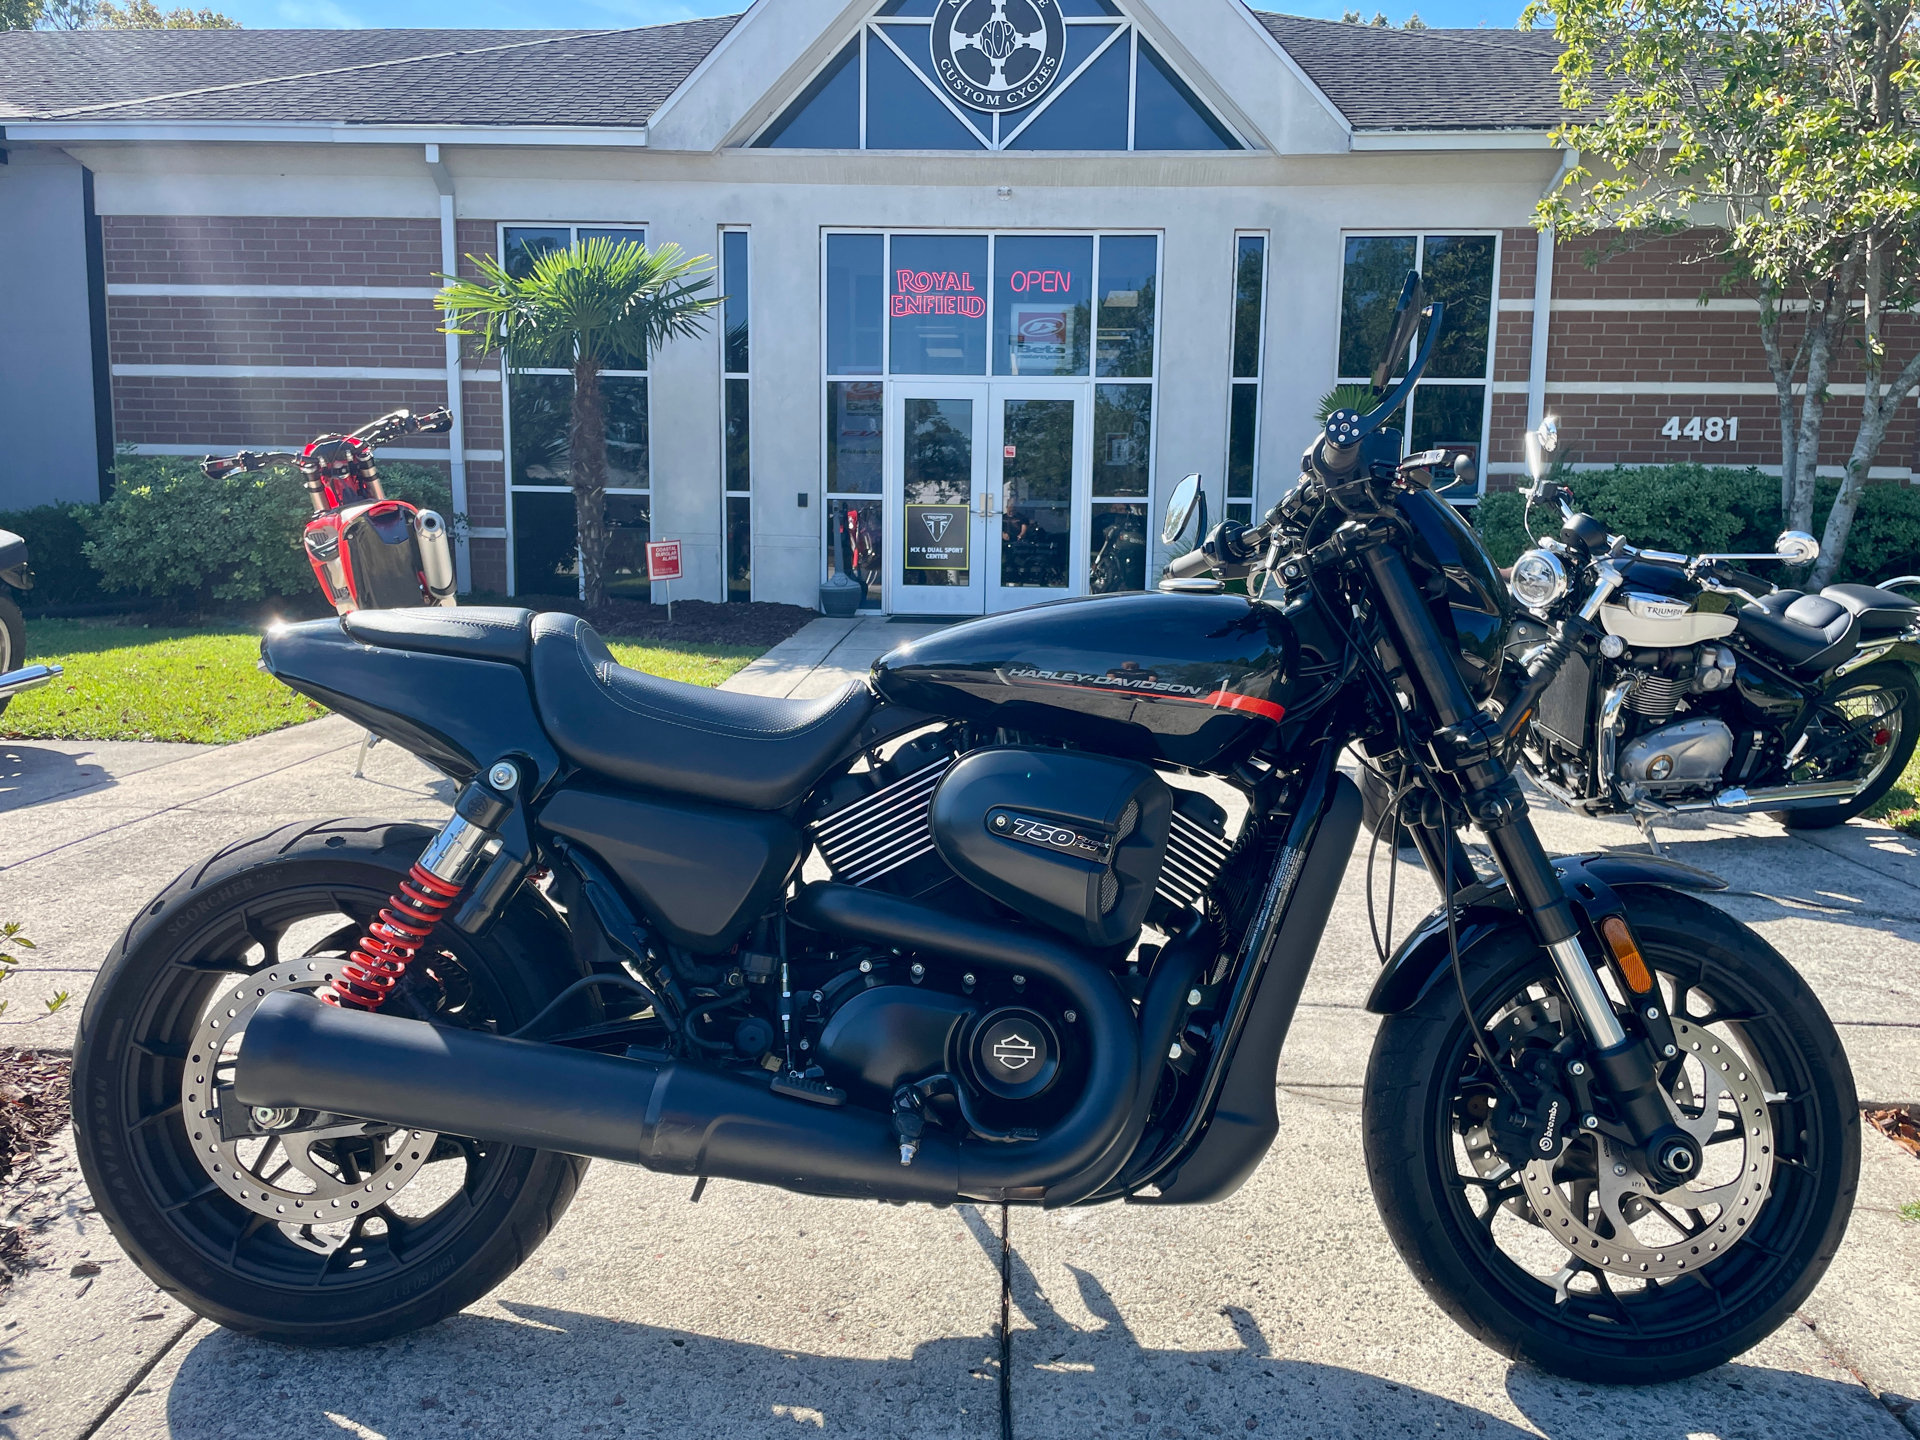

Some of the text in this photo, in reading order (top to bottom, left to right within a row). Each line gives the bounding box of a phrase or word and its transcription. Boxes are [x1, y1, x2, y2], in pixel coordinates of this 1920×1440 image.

[940, 56, 1056, 106] CUSTOM CYCLES
[896, 269, 975, 293] ROYAL
[1010, 270, 1071, 292] OPEN
[890, 295, 986, 319] ENFIELD
[1017, 344, 1066, 354] Beta
[1661, 416, 1739, 441] 4481
[1647, 606, 1684, 618] TRIUMPH
[1008, 668, 1203, 695] HARLEY-DAVIDSON
[1013, 817, 1076, 847] 750
[166, 878, 255, 937] SCORCHER
[1543, 1101, 1558, 1138] brembo
